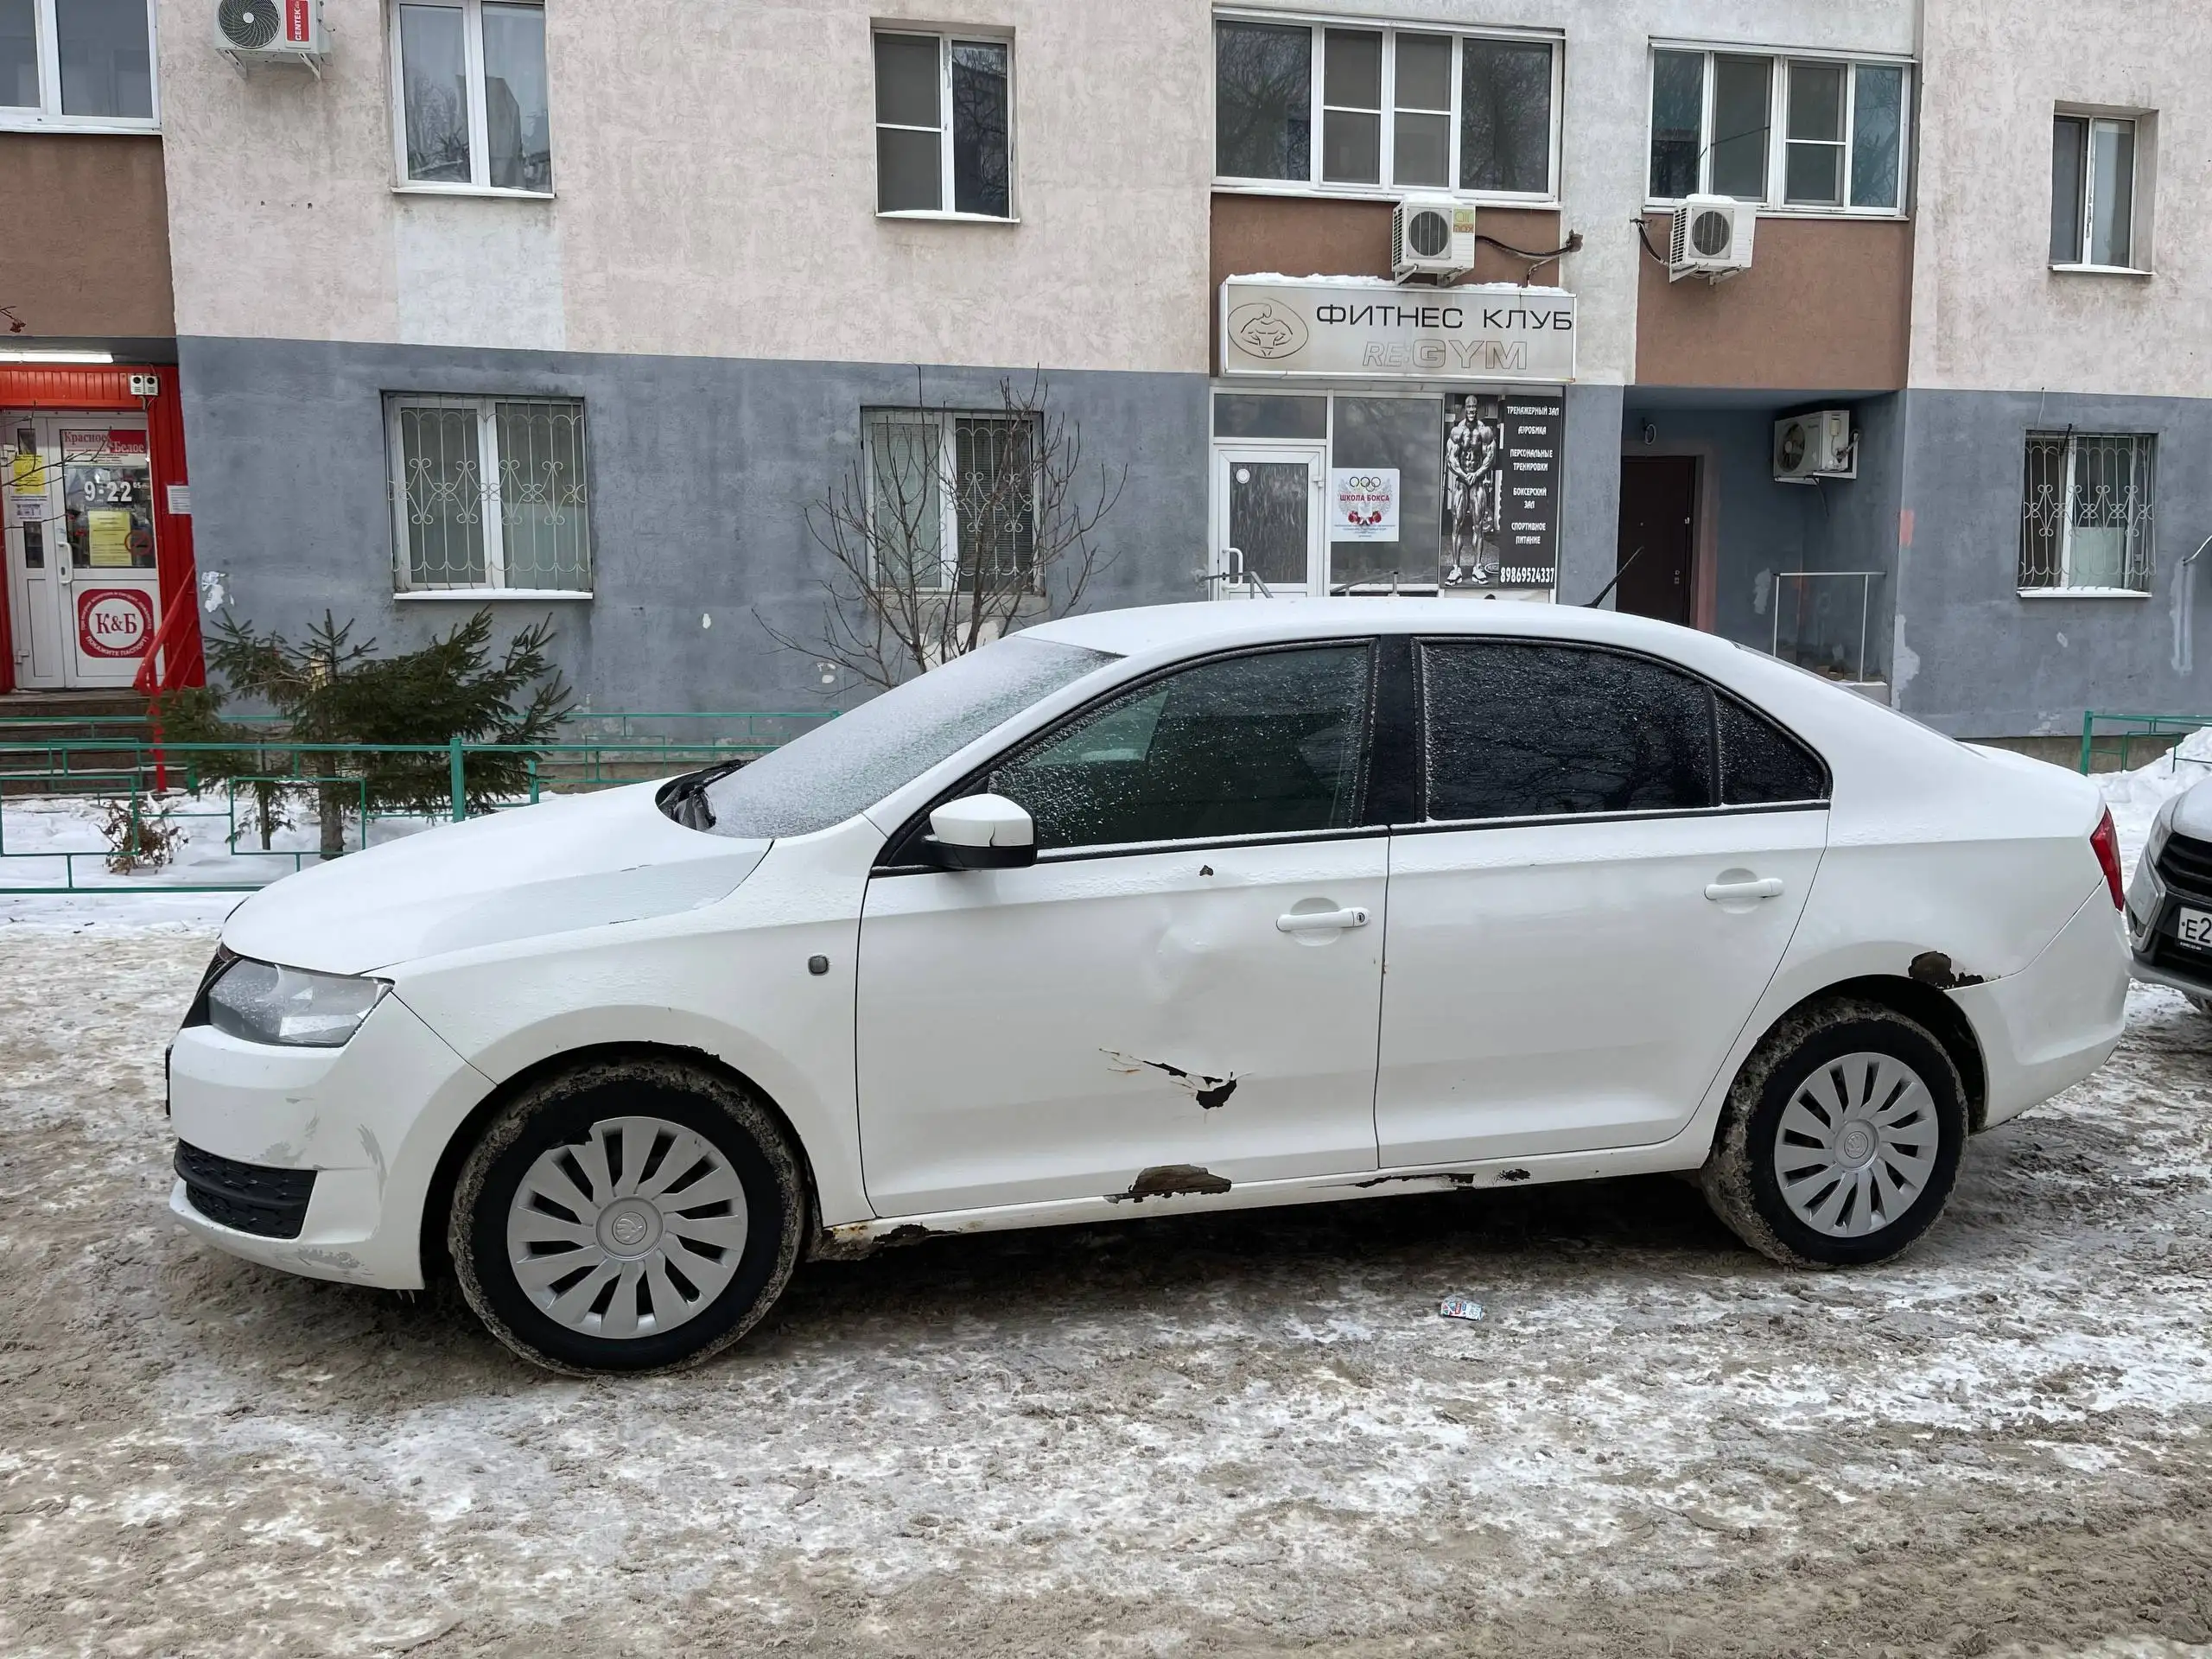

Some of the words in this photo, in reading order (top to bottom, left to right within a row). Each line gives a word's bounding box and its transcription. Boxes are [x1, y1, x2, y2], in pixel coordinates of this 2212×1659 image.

[1316, 303, 1463, 329] ФИТНЕС
[1484, 308, 1573, 331] КЛУБ
[1506, 406, 1548, 416] ТРЕНАЖЕРНЫЙ
[1548, 407, 1560, 416] ЗАЛ
[1517, 425, 1547, 435] АЭРОБИКА
[64, 432, 107, 445] Красное
[112, 441, 145, 453] Белое
[1510, 448, 1554, 458] ПЕРСОНАЛЬНЫЕ
[1513, 462, 1548, 472] ТРЕНИРОВКИ
[1513, 486, 1548, 497] БОКСЕРСКИЙ
[1523, 500, 1535, 509] ЗАЛ
[1510, 522, 1547, 531] СПОРТИВНОЕ
[1516, 536, 1541, 545] ПИТАНИЕ
[1500, 566, 1555, 583] 89869524337
[95, 613, 137, 634] К&Б
